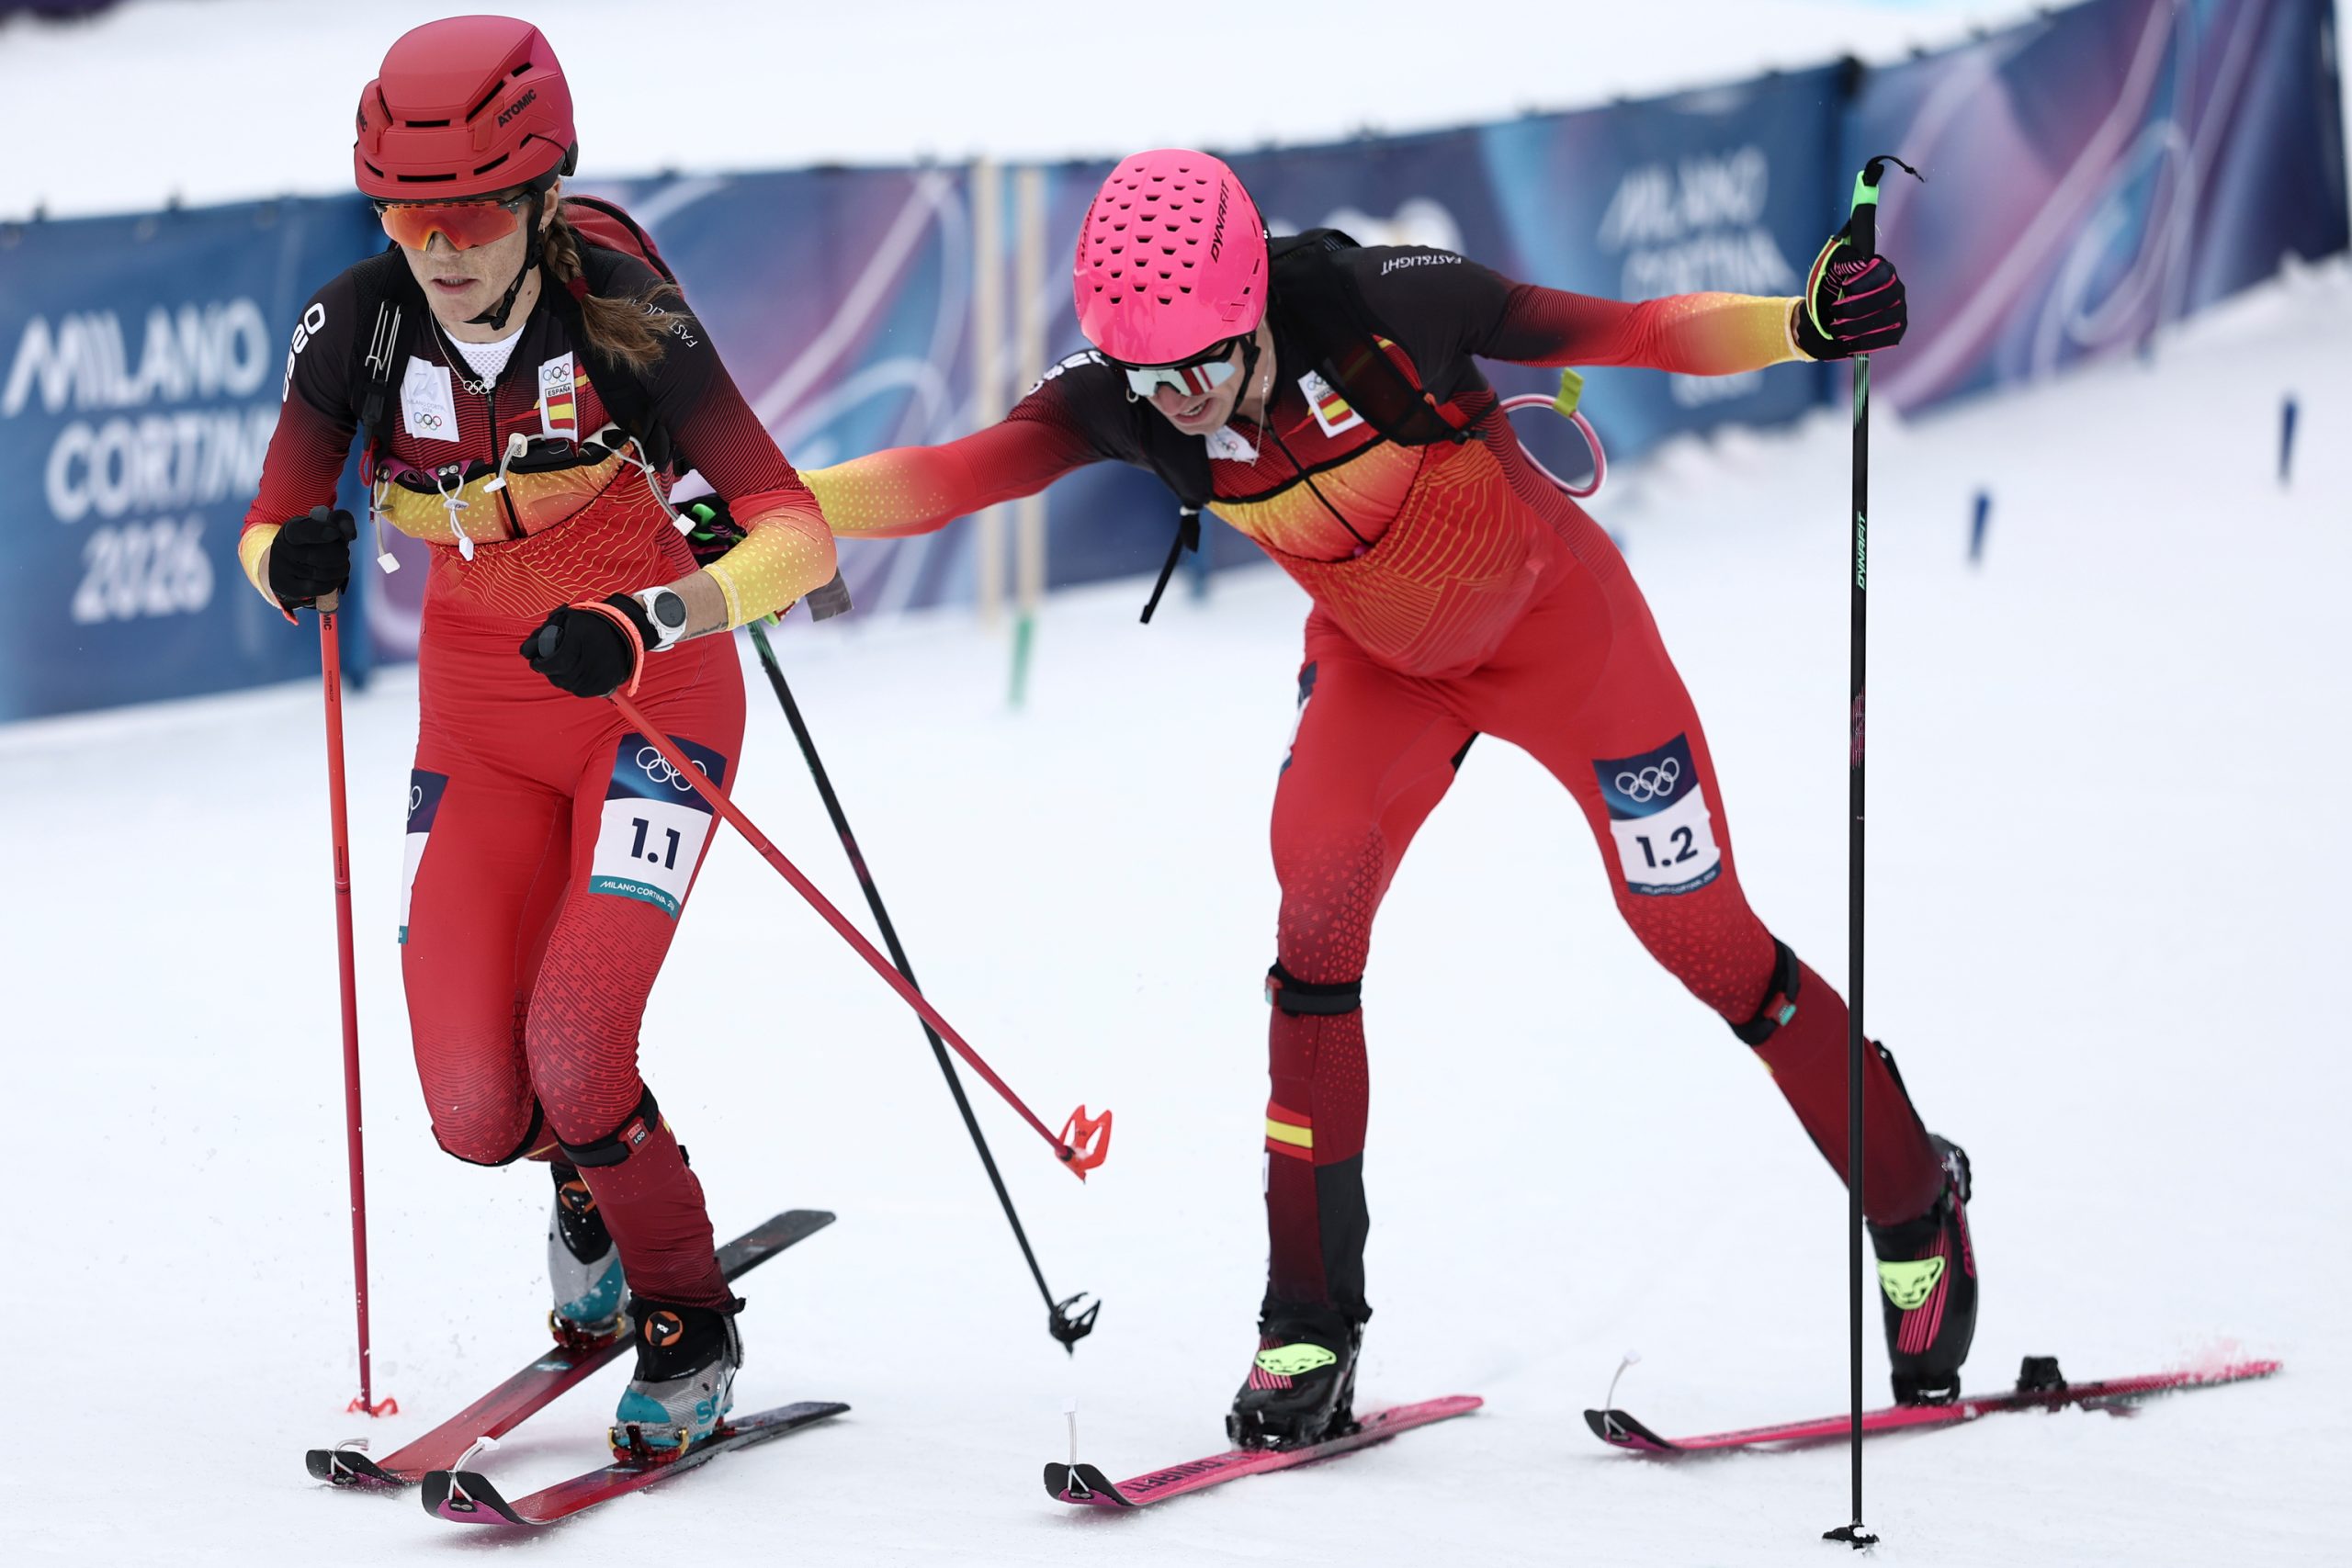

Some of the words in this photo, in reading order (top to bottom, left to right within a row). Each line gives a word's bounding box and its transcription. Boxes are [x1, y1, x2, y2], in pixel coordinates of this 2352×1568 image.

[497, 89, 537, 128] ATOMIC
[1210, 179, 1229, 264] DYNAFIT
[1380, 254, 1462, 276] FAST&LIGHT
[2, 298, 269, 418] MILANO
[547, 385, 571, 396] ESPAÑA
[44, 404, 278, 524] CORTIN
[72, 514, 215, 625] 2026
[1857, 511, 1866, 591] DYNAFIT
[631, 817, 681, 871] 1.1
[1635, 826, 1698, 868] 1.2
[600, 881, 637, 893] MILANO
[637, 886, 667, 905] CORTINA
